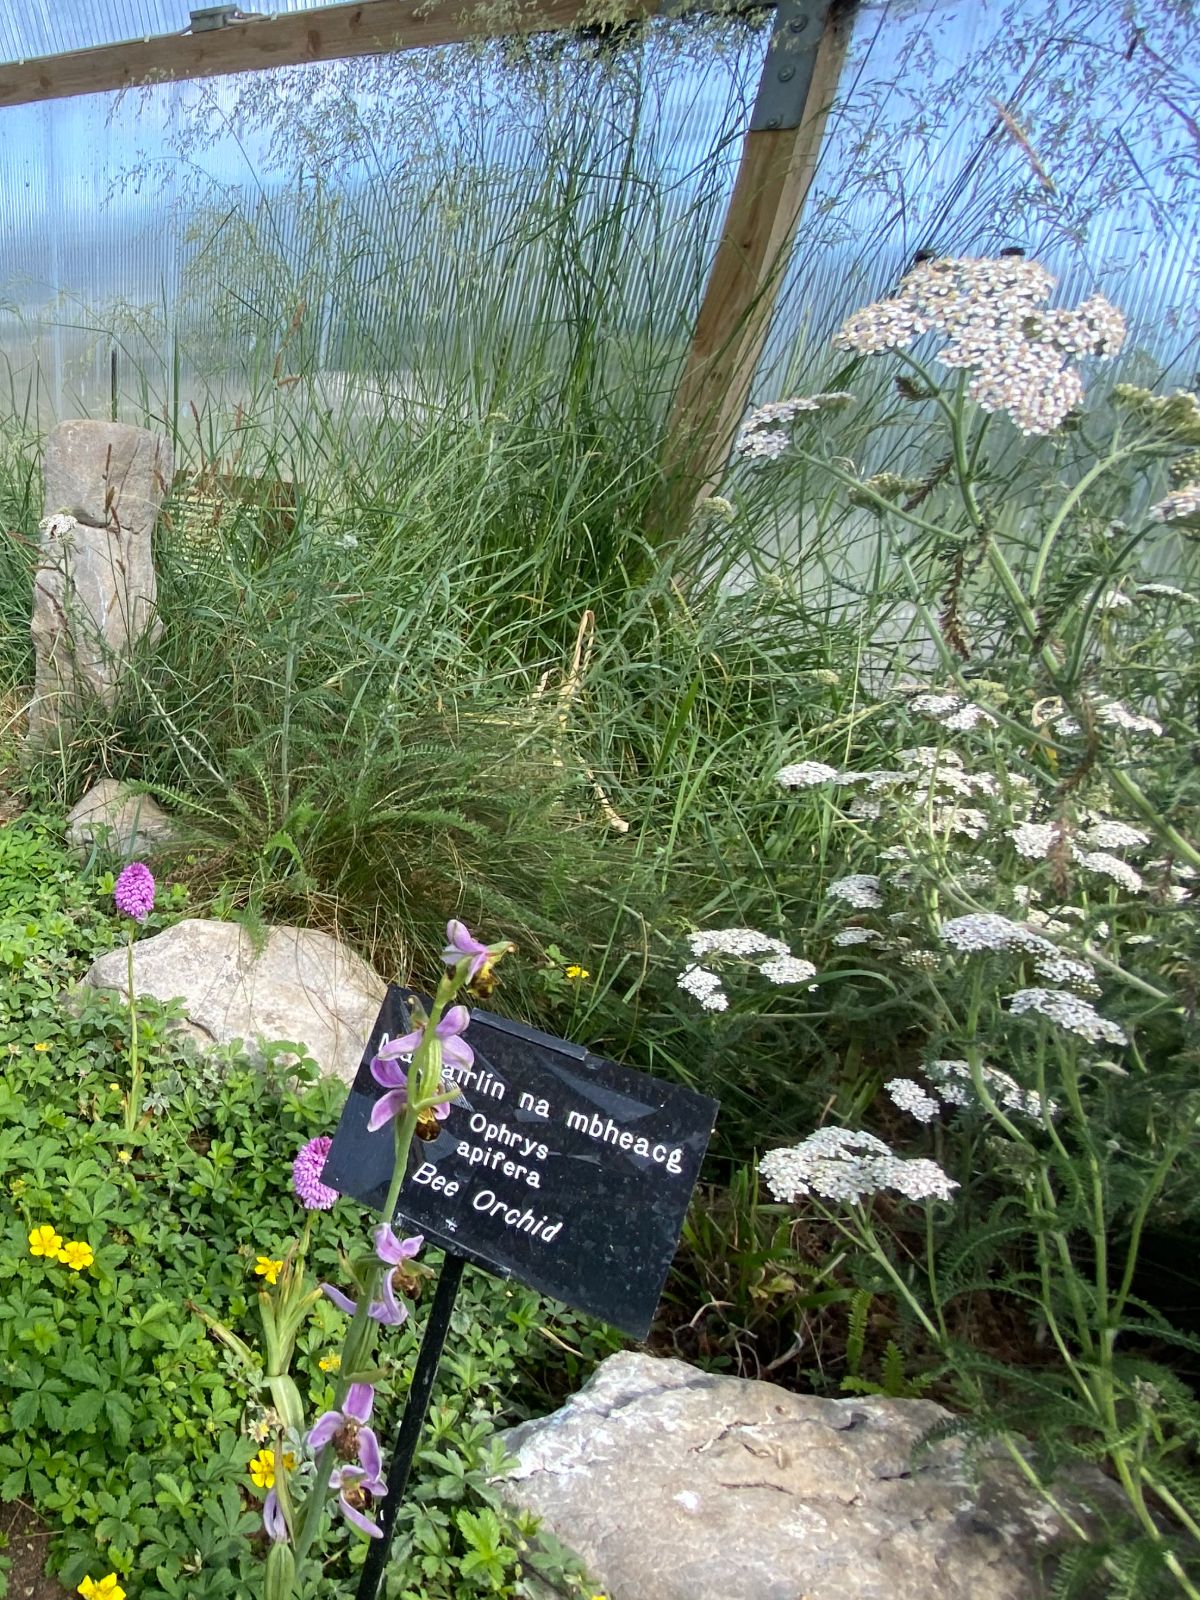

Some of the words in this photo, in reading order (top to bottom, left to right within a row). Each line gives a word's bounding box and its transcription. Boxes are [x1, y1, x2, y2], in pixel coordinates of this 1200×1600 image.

[457, 1141, 540, 1190] apifera
[469, 1113, 548, 1161] Ophrys
[519, 1092, 550, 1118] na
[567, 1109, 683, 1175] mbheacg
[412, 1163, 460, 1197] Bee
[473, 1189, 564, 1243] Orchid
